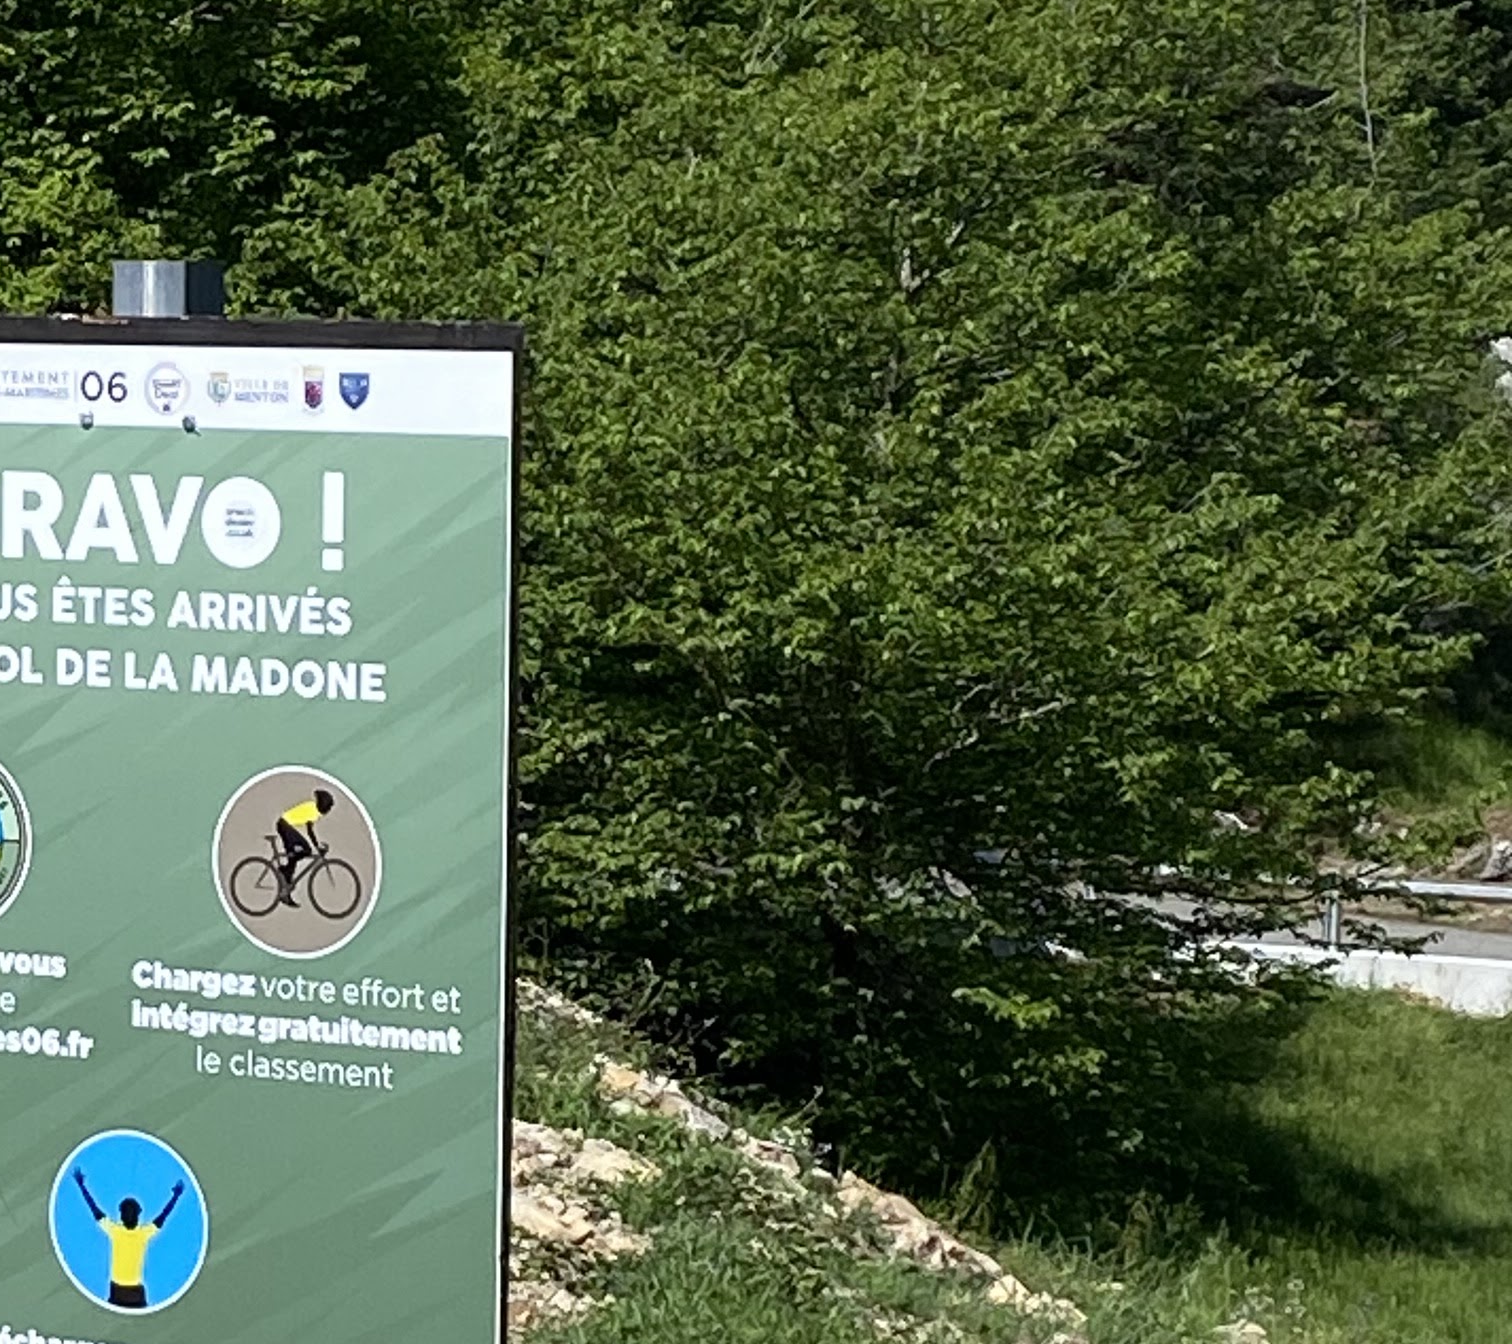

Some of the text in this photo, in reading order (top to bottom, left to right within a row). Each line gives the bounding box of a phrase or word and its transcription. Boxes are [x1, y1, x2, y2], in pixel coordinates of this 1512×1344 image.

[79, 369, 129, 404] 06
[320, 470, 346, 572] !
[51, 574, 157, 628] ÊTES
[166, 585, 354, 637] ARRIVÉS
[55, 647, 112, 689] DE
[123, 650, 180, 693] LA
[190, 653, 388, 703] MADONE
[130, 959, 462, 1015] Chargez votre effort et
[257, 1014, 464, 1056] gratuitement
[195, 1044, 394, 1091] le classement
